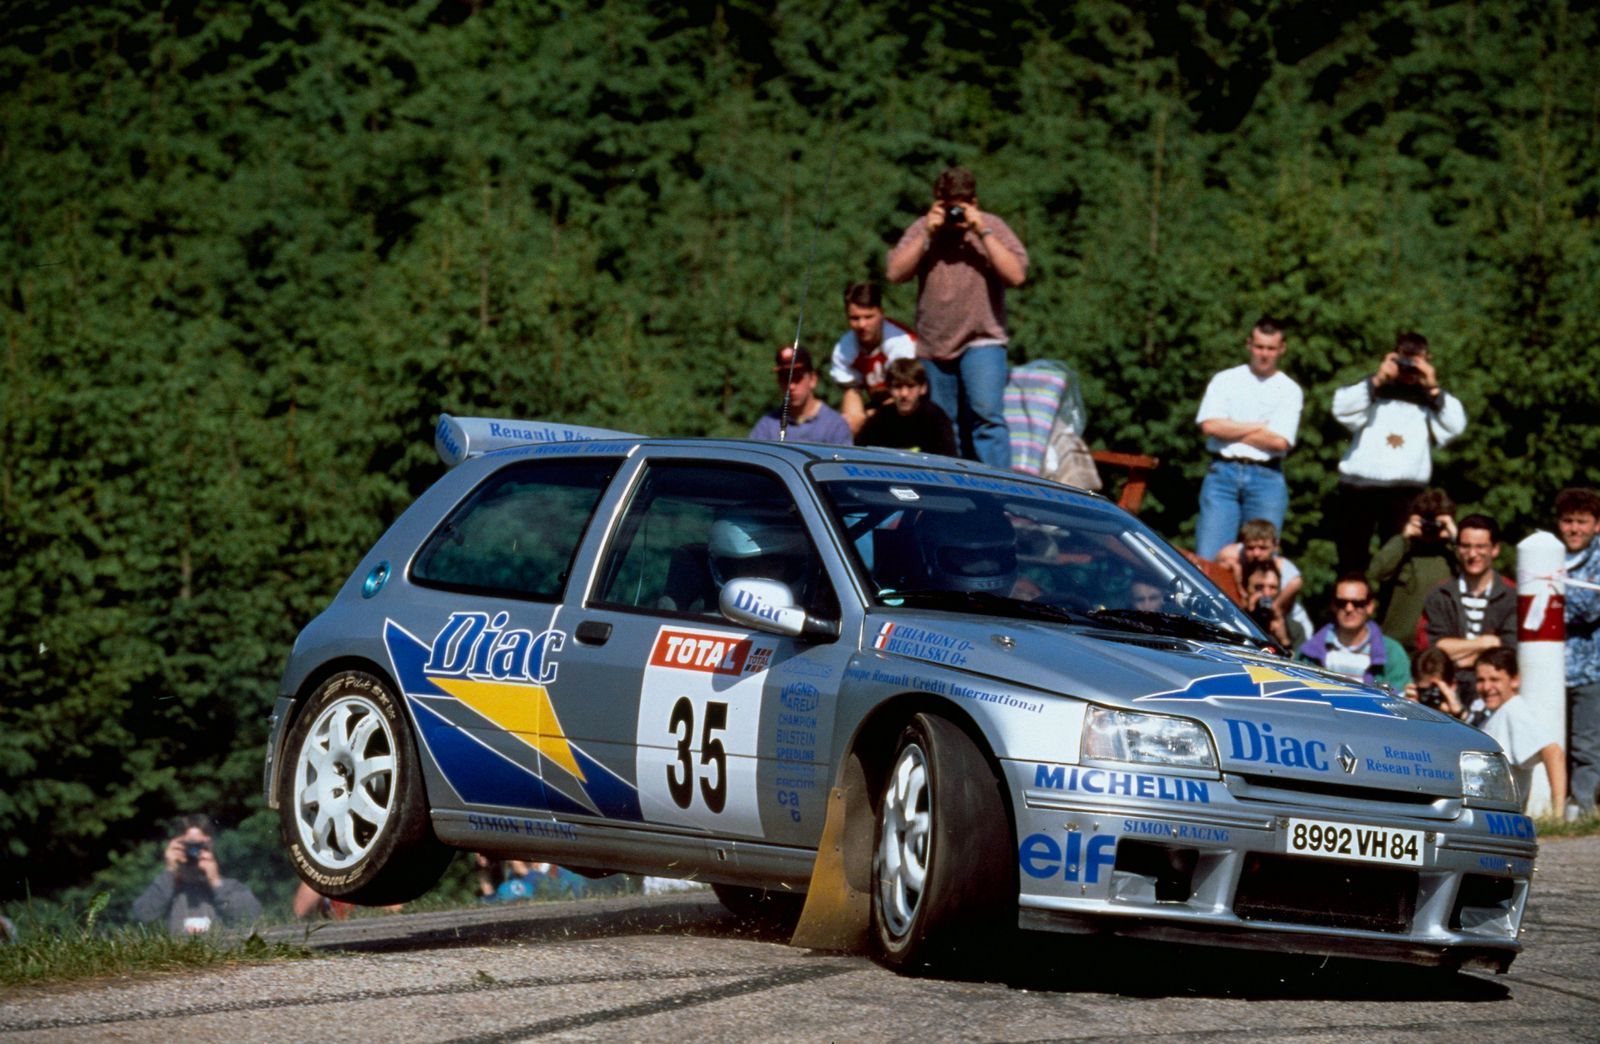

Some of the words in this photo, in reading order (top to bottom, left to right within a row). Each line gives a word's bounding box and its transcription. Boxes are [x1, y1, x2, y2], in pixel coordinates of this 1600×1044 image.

[489, 422, 557, 442] Renault
[843, 463, 941, 483] Renault
[733, 588, 789, 623] Diac
[423, 610, 567, 685] Diac
[888, 638, 948, 663] BUGALSKI
[893, 624, 955, 650] CHIARONI
[664, 635, 738, 671] TOTAL
[747, 655, 769, 667] TOTAL
[872, 668, 910, 688] Renault
[949, 682, 1045, 714] International
[778, 712, 817, 729] CHAMPION
[775, 728, 816, 747] BILSTEIN
[1222, 718, 1329, 772] Diac
[665, 695, 729, 815] 35
[1383, 745, 1433, 763] Renault
[1366, 758, 1411, 776] Réseau
[1413, 763, 1456, 781] France
[1034, 763, 1210, 804] MICHELIN
[468, 814, 520, 833] SIMON
[525, 819, 578, 841] RACING
[1123, 819, 1173, 837] SIMON
[1178, 825, 1231, 842] RACING
[1292, 823, 1353, 854] 8992
[1356, 828, 1388, 858] VH
[1390, 833, 1419, 861] 84
[291, 843, 348, 887] MICHELIN
[1019, 831, 1116, 884] elf
